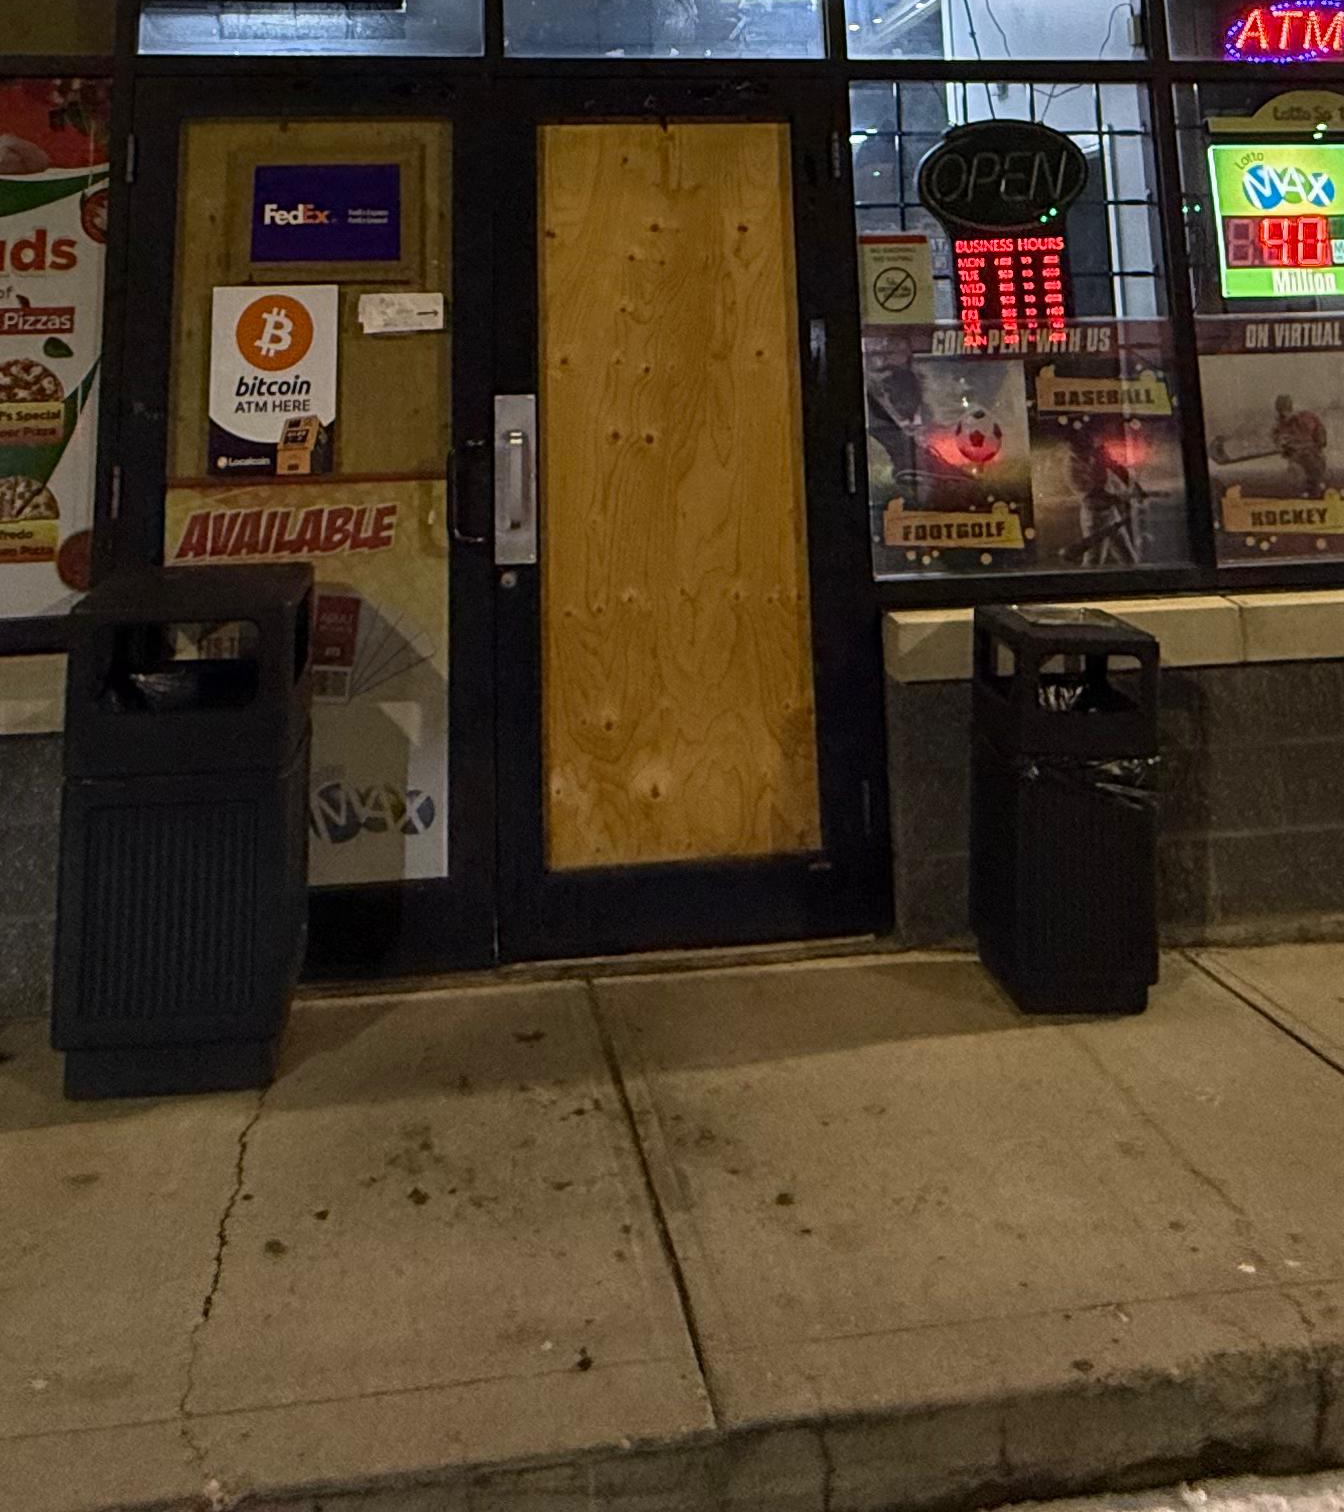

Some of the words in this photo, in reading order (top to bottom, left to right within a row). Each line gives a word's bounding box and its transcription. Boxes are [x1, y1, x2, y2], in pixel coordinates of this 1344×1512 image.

[1272, 105, 1311, 122] Lotto
[1235, 151, 1265, 170] Lotto
[930, 150, 1069, 205] OPEN
[1243, 164, 1335, 209] MAX
[264, 203, 330, 226] FedEx
[955, 239, 1014, 254] BUSINESS
[1017, 236, 1065, 251] HOURS
[957, 257, 985, 268] MON
[958, 270, 980, 281] TUE
[1273, 269, 1336, 293] Million
[5, 311, 72, 330] Pizzas
[987, 328, 1030, 355] PLAY
[1036, 328, 1083, 353] WITH
[1086, 327, 1111, 352] US
[1245, 324, 1269, 348] ON
[1274, 321, 1342, 347] VIRTUAL
[235, 374, 311, 397] bitcoin
[235, 400, 268, 414] ATM
[272, 398, 311, 412] HERE
[1053, 387, 1154, 407] BASEBALL
[15, 409, 61, 423] Special
[1251, 507, 1328, 527] HOCKEY
[175, 504, 398, 559] AVAILABLE
[902, 520, 1006, 541] FOOTGOLF
